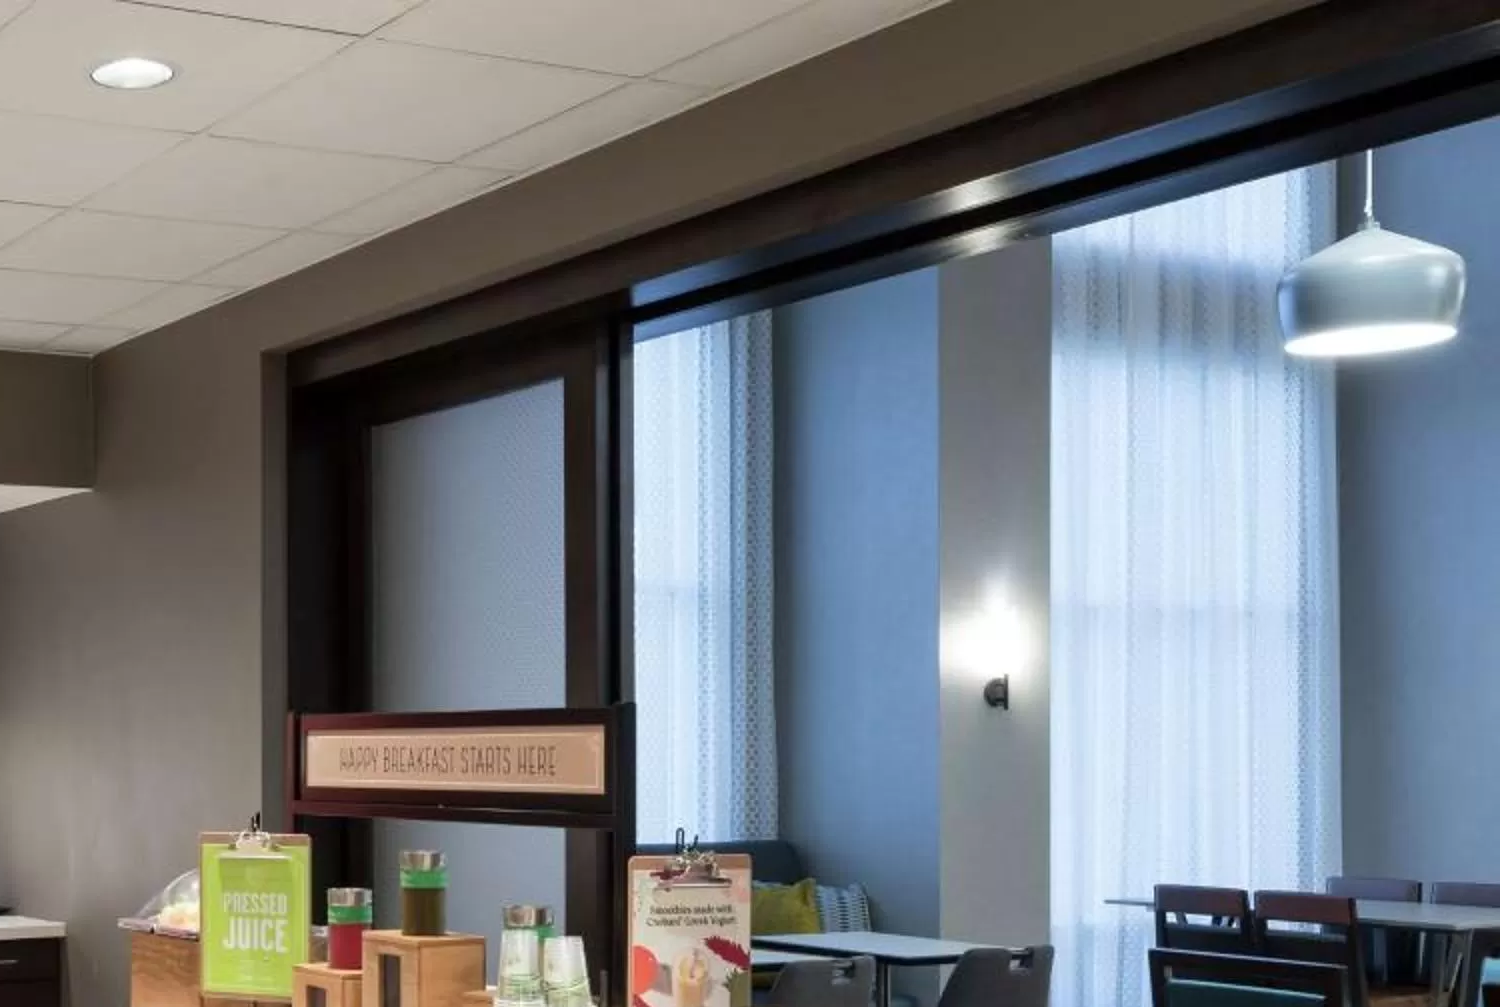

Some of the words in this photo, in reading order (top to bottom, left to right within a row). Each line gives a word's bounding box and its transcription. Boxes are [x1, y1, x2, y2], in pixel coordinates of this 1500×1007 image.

[339, 746, 380, 773] HAPPY
[382, 746, 456, 775] BREAKFAST
[460, 746, 512, 776] STARTS
[516, 745, 558, 777] HERE
[223, 892, 289, 915] PRESSED
[222, 916, 289, 953] JUICE
